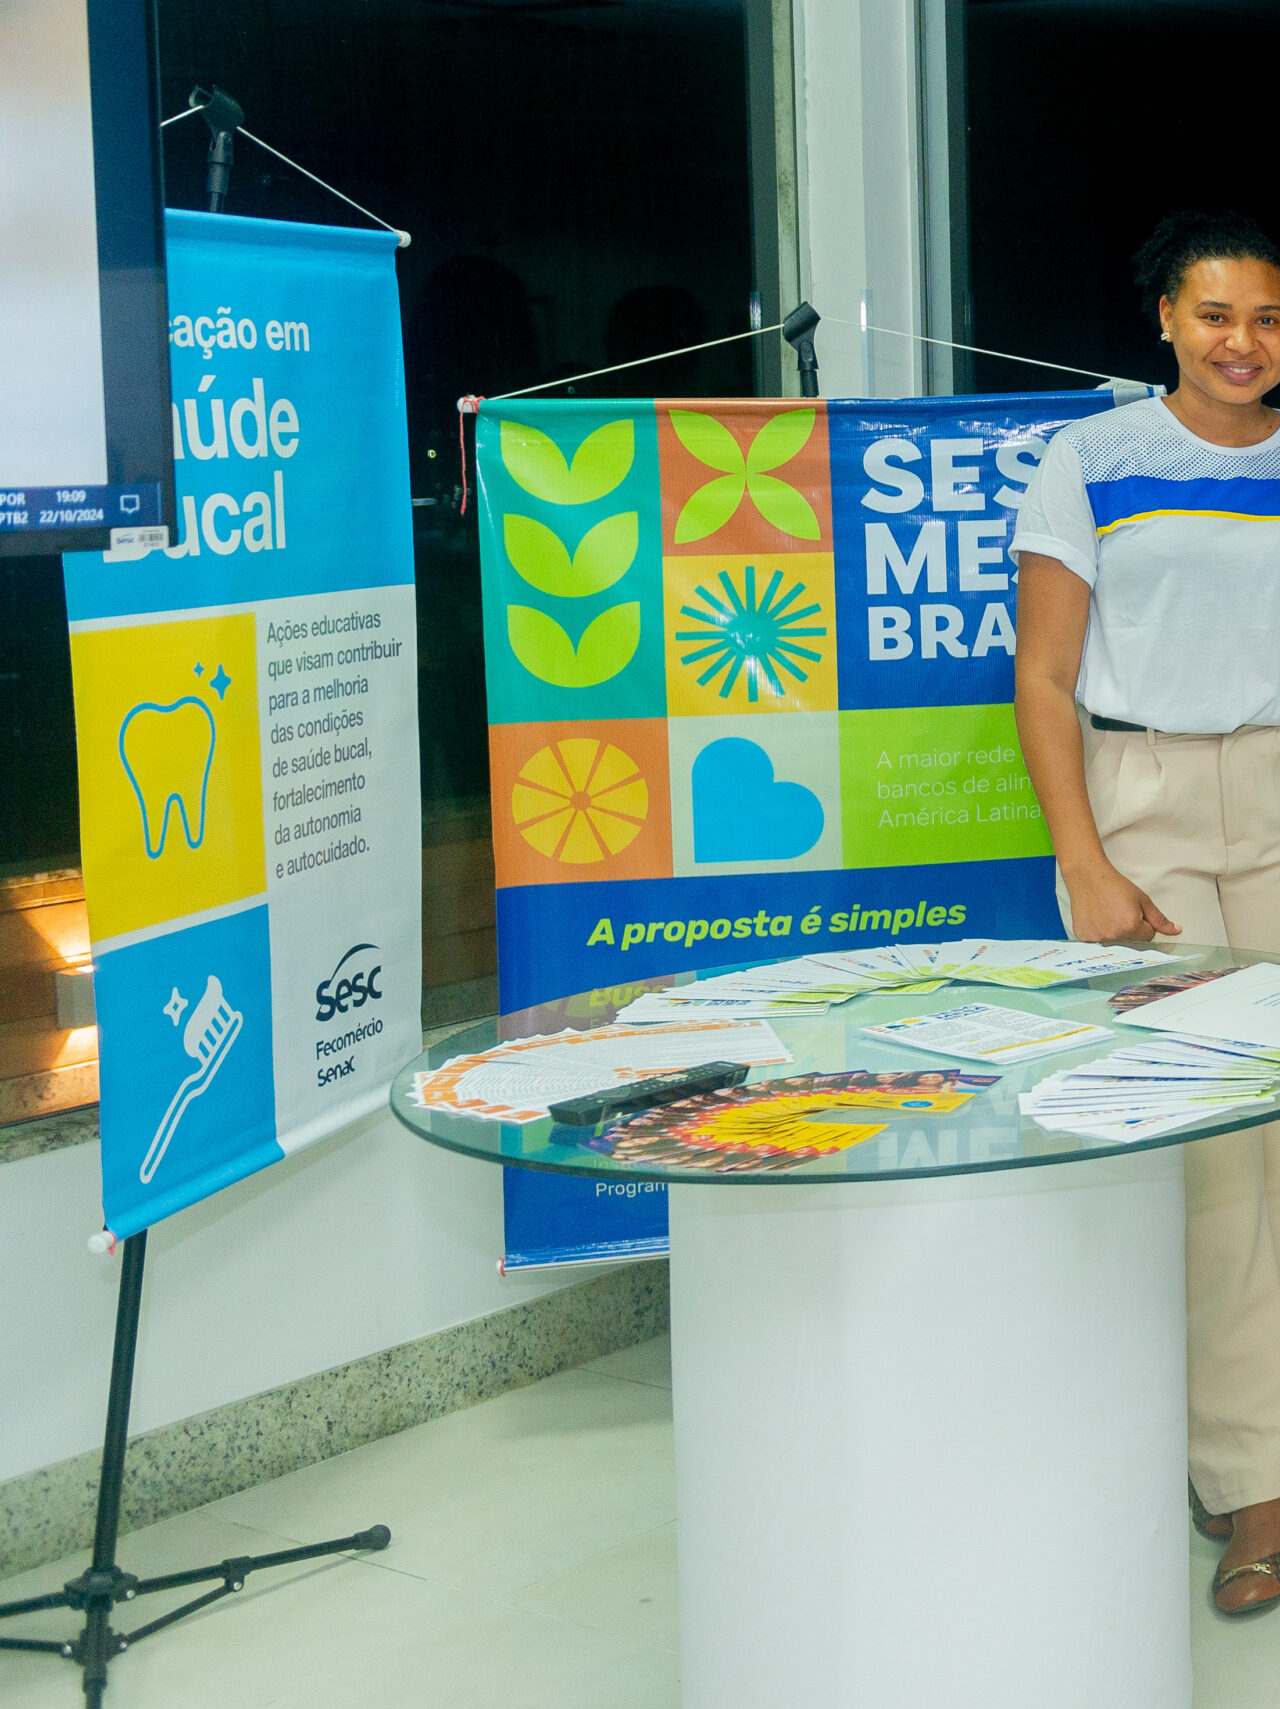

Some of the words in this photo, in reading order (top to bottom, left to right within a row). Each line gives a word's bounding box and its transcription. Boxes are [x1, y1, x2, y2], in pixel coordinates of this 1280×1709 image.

[169, 306, 257, 360] ação
[265, 320, 310, 352] em
[39, 509, 104, 524] 22/10/2024
[56, 490, 86, 503] 19:09
[267, 619, 308, 647] Ações
[311, 611, 381, 637] educativas
[268, 659, 292, 681] que
[296, 651, 333, 673] visam
[337, 638, 402, 664] contribuir
[268, 691, 298, 716] para
[302, 690, 310, 704] a
[313, 675, 369, 703] melhoria
[271, 722, 294, 745] das
[298, 708, 363, 737] condições
[272, 757, 288, 778] de
[291, 748, 331, 773] saúde
[334, 737, 372, 763] bucal,
[877, 750, 892, 769] A
[900, 748, 960, 768] maior
[967, 744, 1016, 765] rede
[273, 771, 366, 812] fortalecimento
[877, 780, 957, 800] bancos
[963, 776, 990, 795] de
[275, 825, 291, 845] da
[294, 805, 361, 840] autonomia
[878, 807, 969, 829] América
[976, 802, 1041, 823] Latina
[276, 862, 284, 879] e
[287, 835, 370, 876] autocuidado.
[586, 918, 615, 946] A
[621, 910, 793, 951] proposta
[800, 905, 822, 935] é
[828, 901, 967, 935] simples
[316, 1018, 383, 1060] Fecomércio
